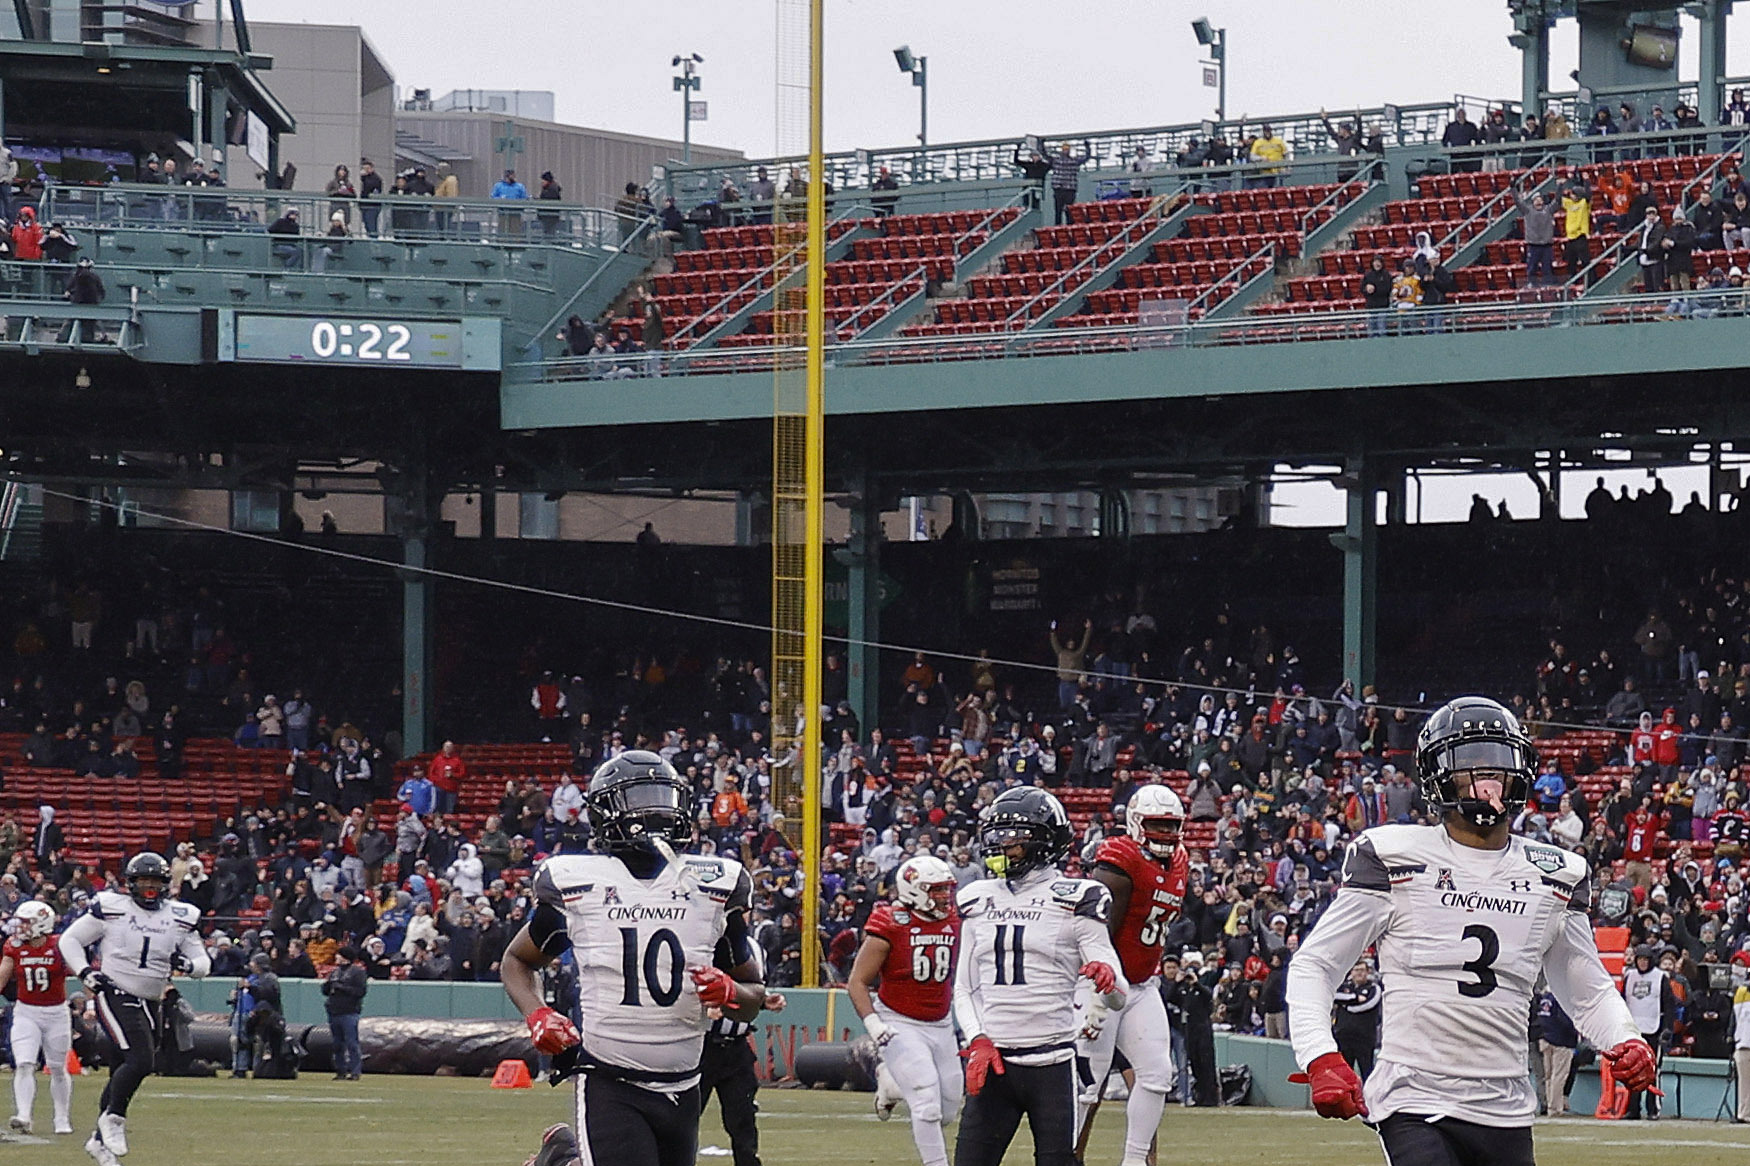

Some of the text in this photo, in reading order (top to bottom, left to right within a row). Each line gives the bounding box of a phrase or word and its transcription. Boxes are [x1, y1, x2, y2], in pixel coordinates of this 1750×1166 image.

[310, 321, 412, 361] 0:22
[1015, 759, 1026, 773] 2
[607, 903, 687, 922] CINCINNATI
[986, 907, 1042, 922] CINCINNATI
[1440, 890, 1527, 916] CINCINNATI
[138, 936, 151, 969] 1
[909, 933, 956, 947] LOUISVILLE
[617, 927, 686, 1008] 10
[911, 945, 952, 983] 68
[993, 924, 1027, 986] 11
[1457, 924, 1501, 998] 3
[24, 967, 50, 992] 19
